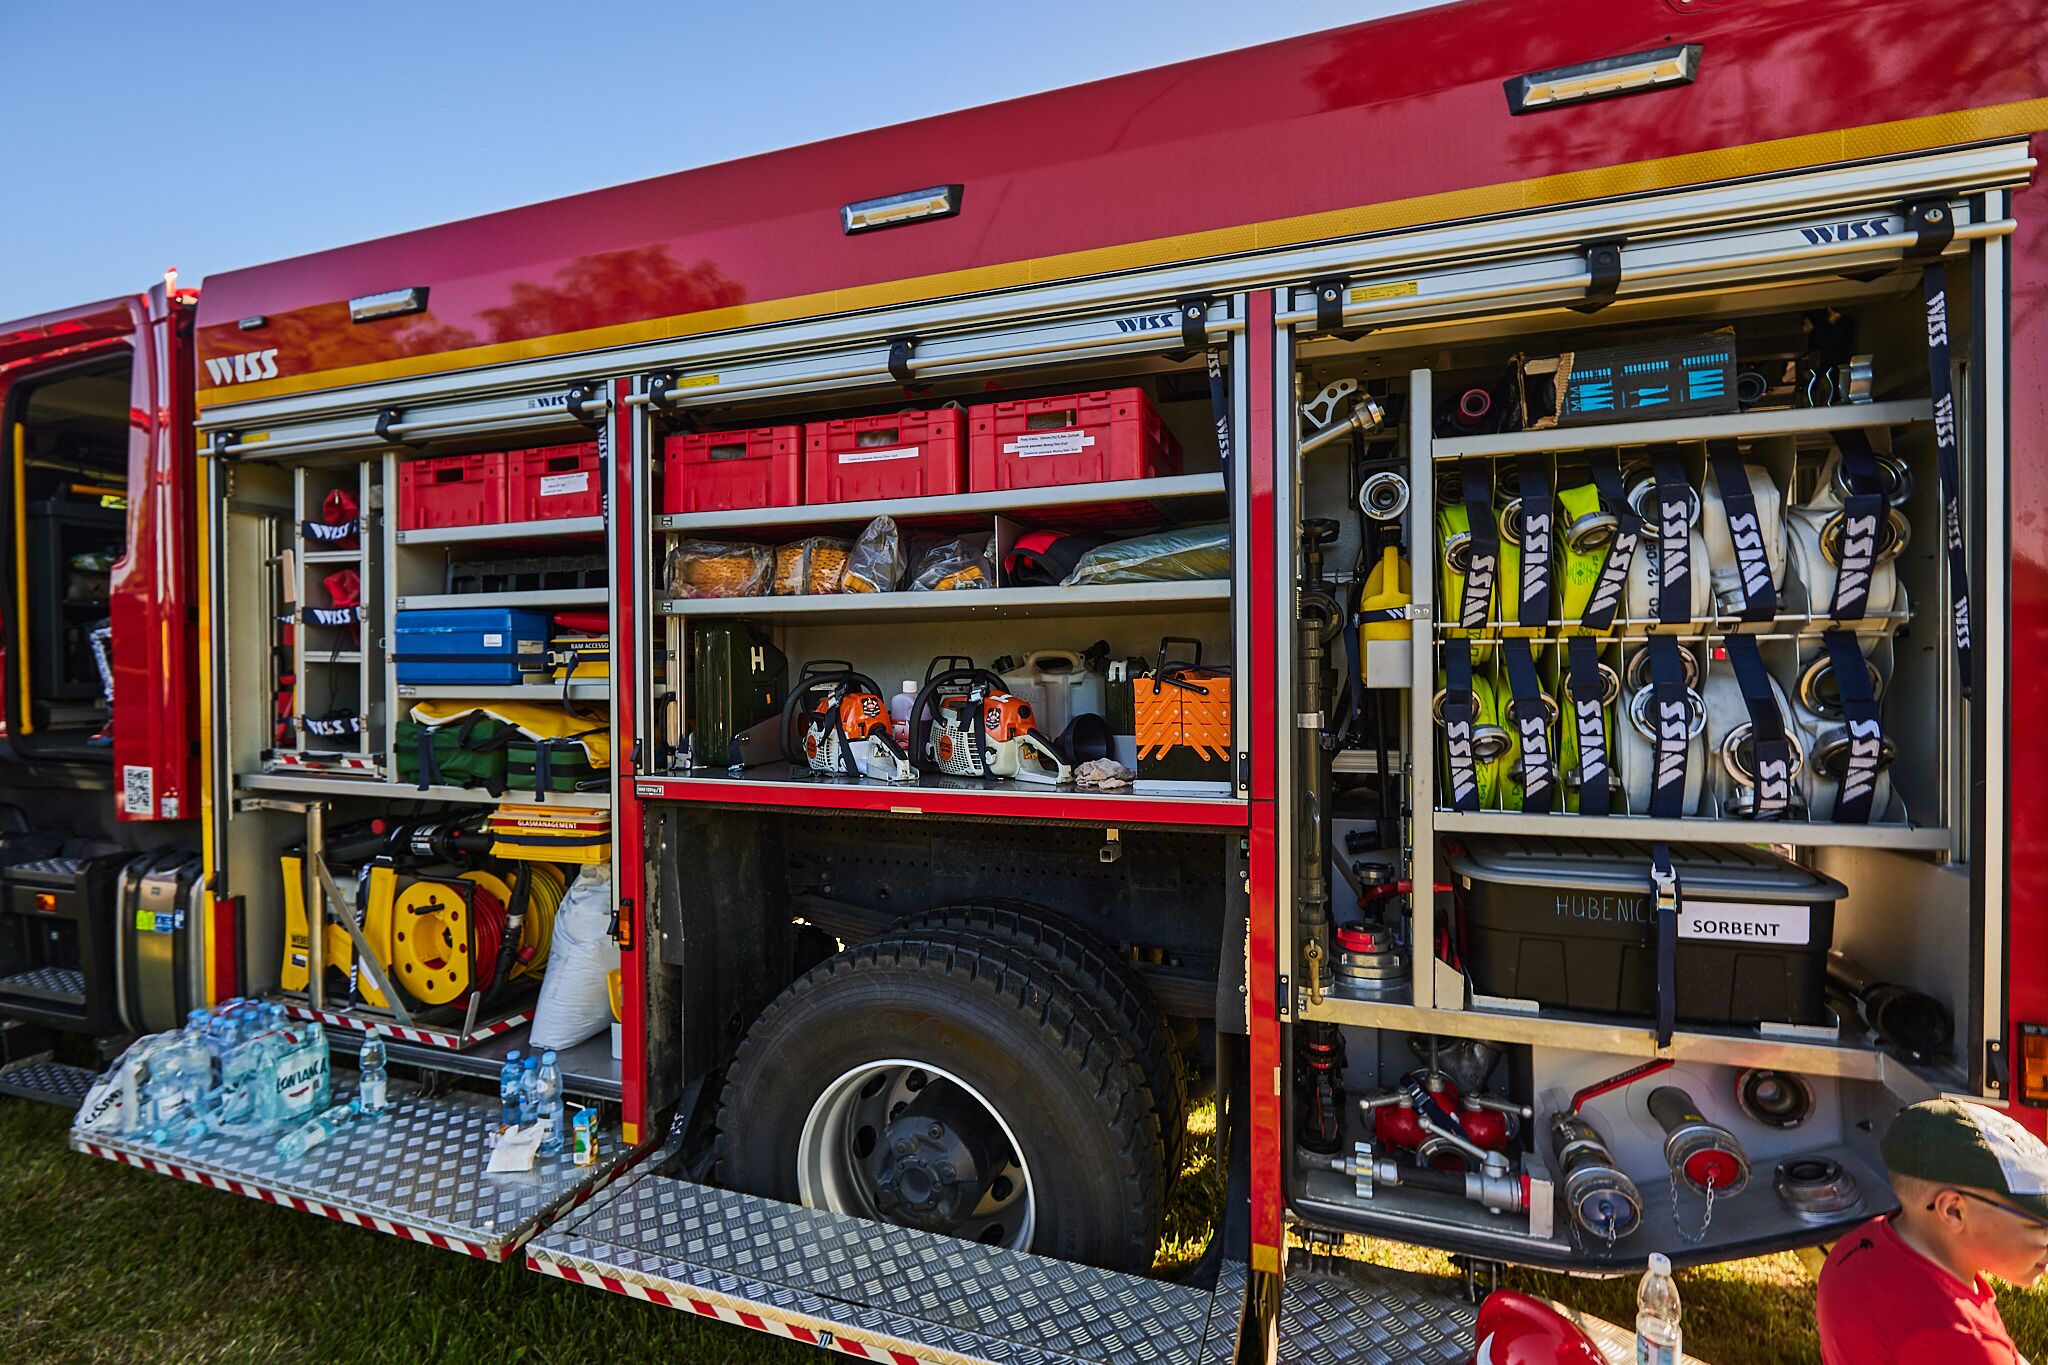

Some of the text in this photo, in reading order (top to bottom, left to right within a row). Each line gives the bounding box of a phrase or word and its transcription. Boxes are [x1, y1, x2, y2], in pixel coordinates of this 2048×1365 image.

[1800, 218, 1889, 245] WISS
[1115, 314, 1174, 333] WISS
[1926, 291, 1948, 347] WISS
[205, 348, 278, 386] WISS
[1207, 353, 1221, 378] ISS
[1216, 415, 1230, 459] WISS
[1934, 393, 1955, 448] WISS
[310, 523, 350, 539] WISS
[1523, 512, 1549, 603] WISS
[1662, 500, 1688, 588] WISS
[1729, 512, 1770, 597] WISS
[1589, 532, 1638, 615] WISS
[1836, 514, 1877, 611] WISS
[313, 609, 350, 624] WISS
[1462, 555, 1495, 628] WISS
[1954, 595, 1971, 650] WISS
[1447, 720, 1475, 803] WISS
[1520, 716, 1549, 798] WISS
[1577, 699, 1607, 783] WISS
[1657, 701, 1687, 790] WISS
[1842, 719, 1881, 804] WISS
[1759, 759, 1788, 811] ISS
[517, 820, 577, 830] GLASMANAGEMENT
[1693, 920, 1780, 937] SORBENT
